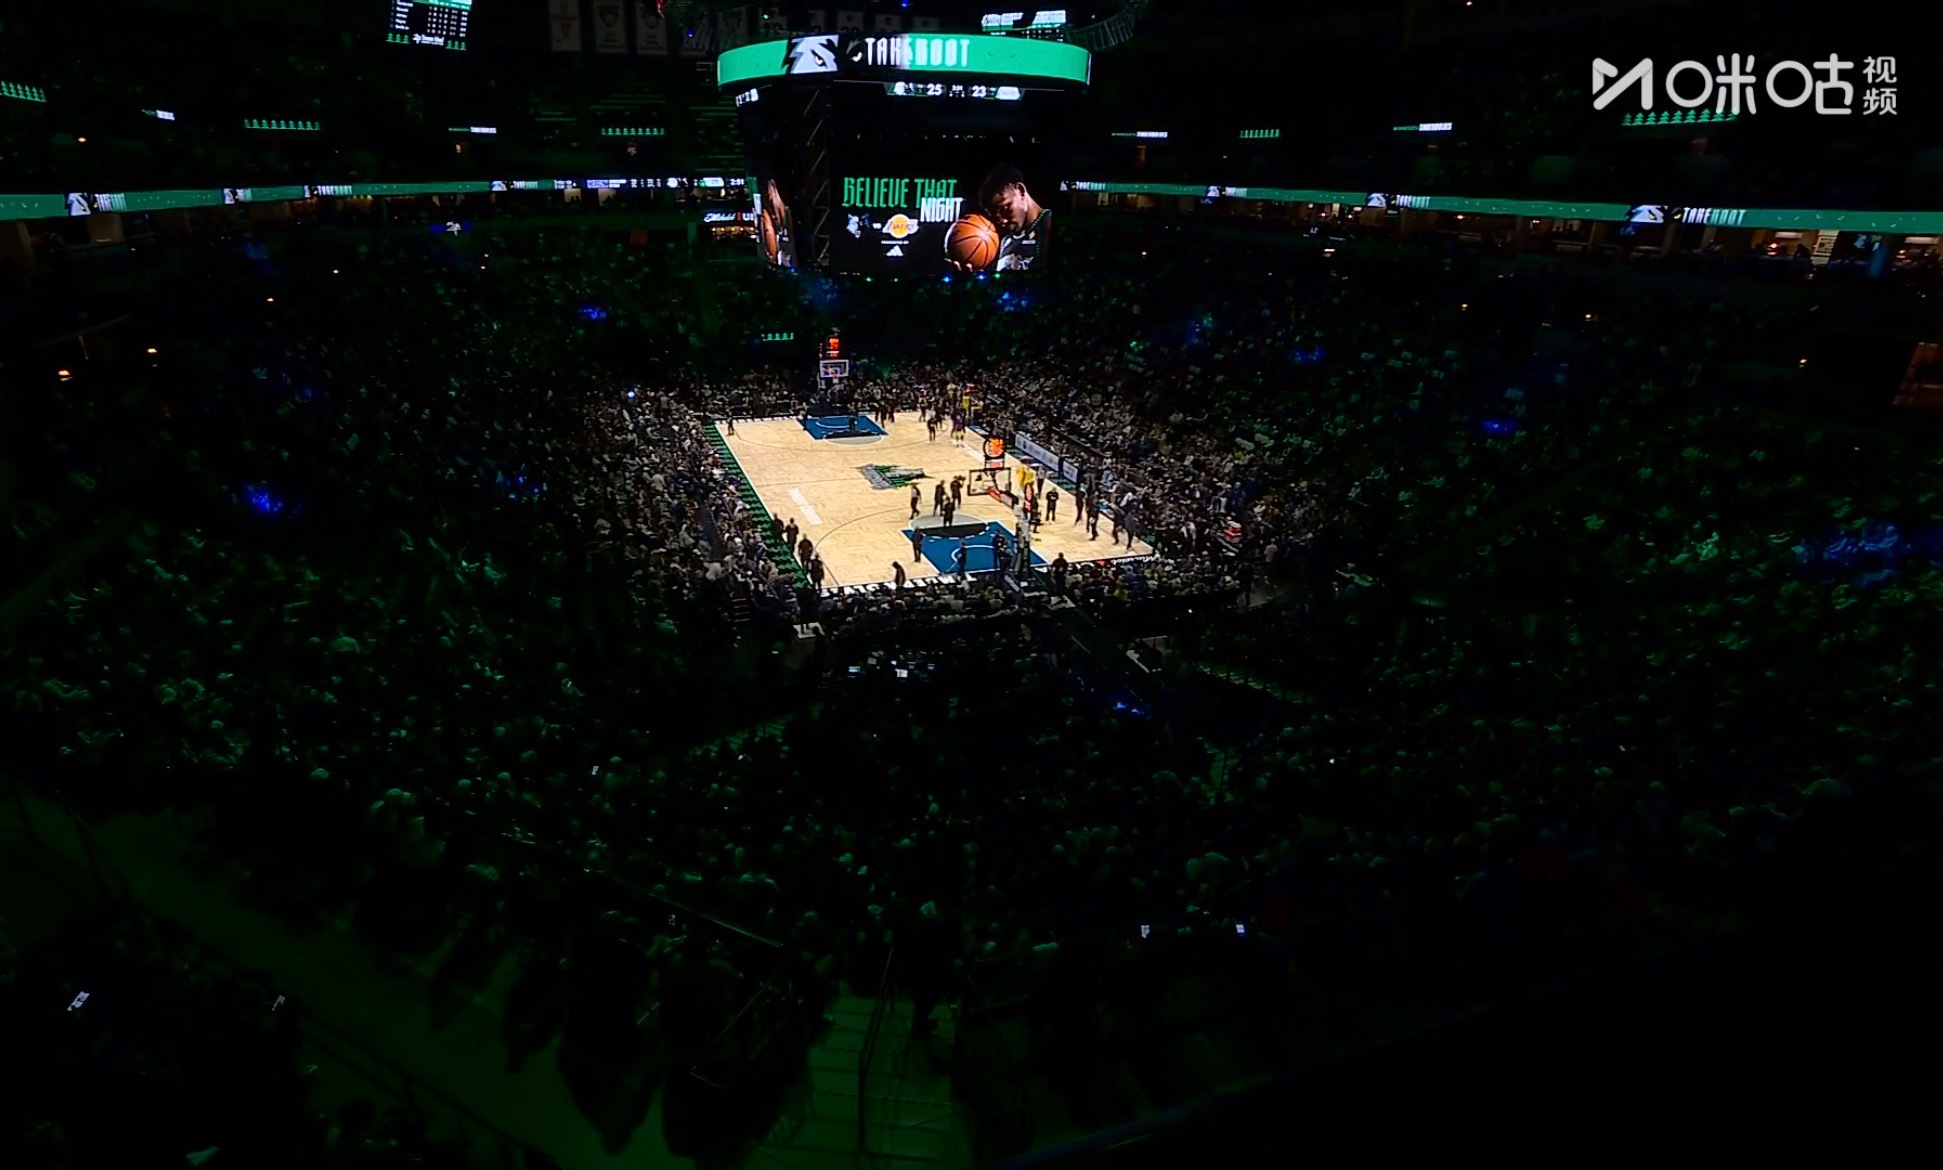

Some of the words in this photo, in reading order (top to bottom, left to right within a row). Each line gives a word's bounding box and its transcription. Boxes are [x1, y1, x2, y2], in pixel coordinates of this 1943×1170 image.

[927, 83, 942, 96] 25
[972, 85, 987, 97] 23
[842, 177, 910, 208] BELIEVE
[914, 178, 958, 209] THAT
[920, 196, 964, 222] NIGHT
